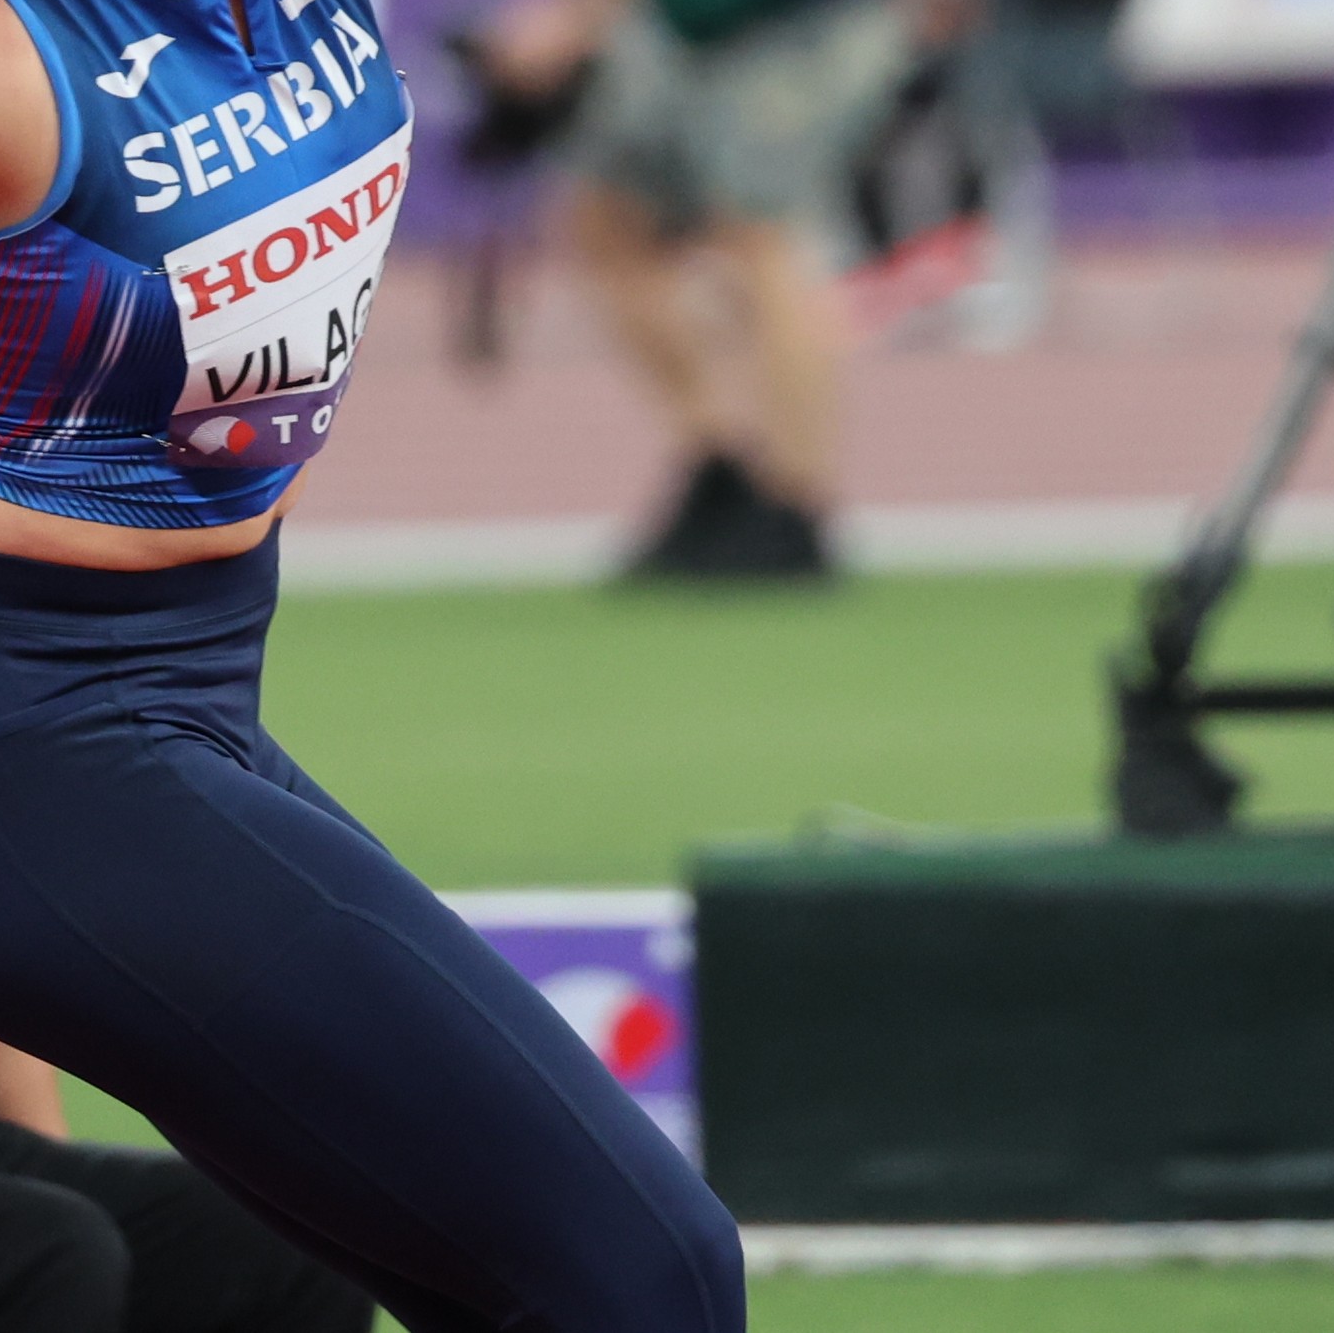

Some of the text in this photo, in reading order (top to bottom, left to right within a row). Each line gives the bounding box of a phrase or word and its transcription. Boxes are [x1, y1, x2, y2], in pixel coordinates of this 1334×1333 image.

[122, 7, 380, 214] SERBIA
[180, 153, 408, 321] HOND
[271, 396, 337, 445] TO
